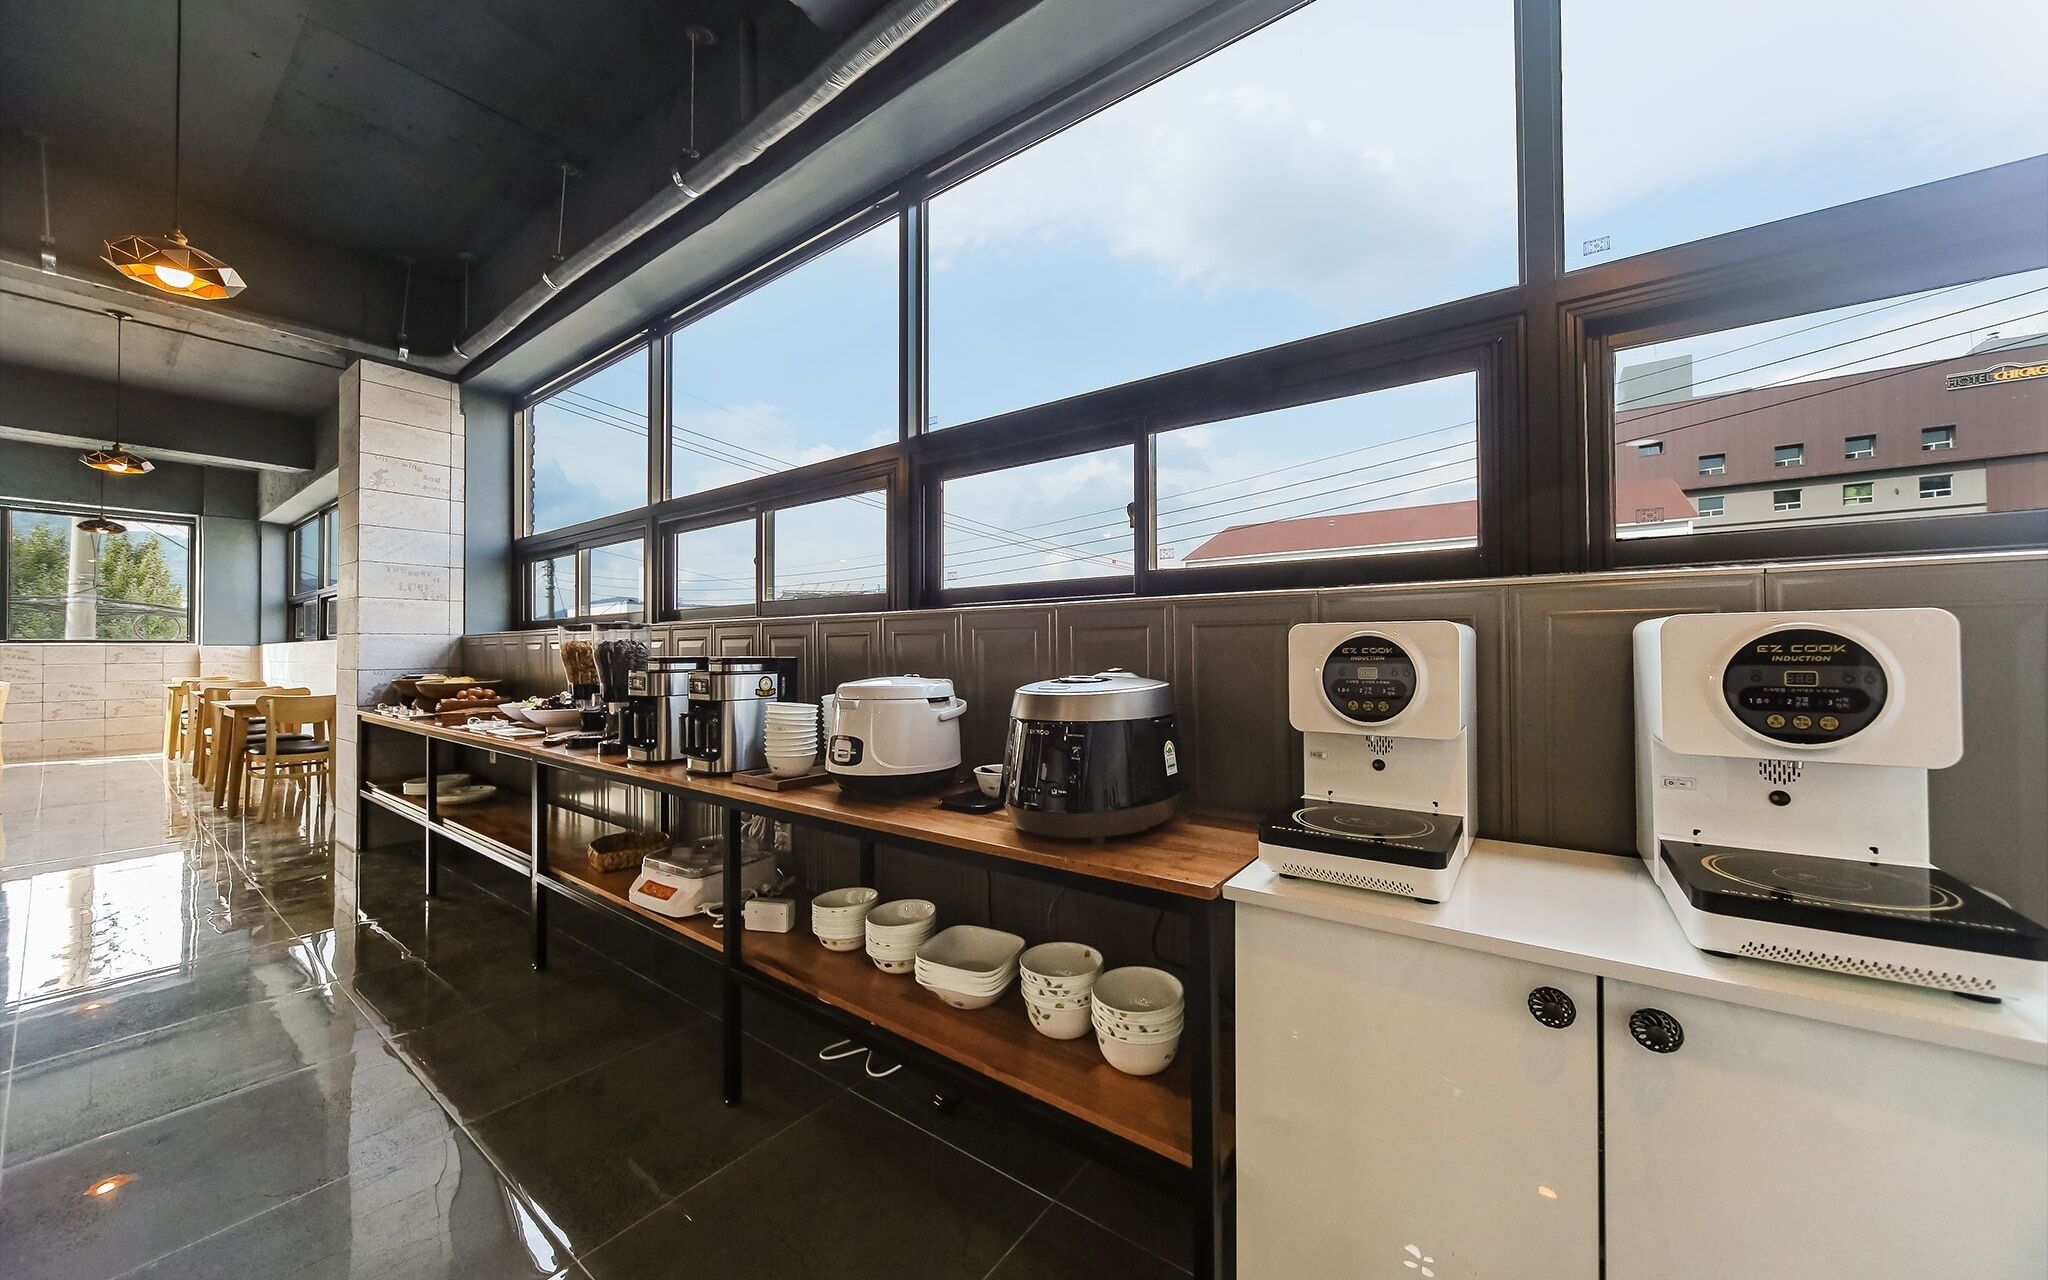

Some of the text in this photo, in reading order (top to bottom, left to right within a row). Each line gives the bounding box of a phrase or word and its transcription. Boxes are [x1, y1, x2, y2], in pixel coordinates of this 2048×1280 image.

[1947, 374, 1991, 388] HOTEL
[1757, 644, 1847, 653] EZ COOK
